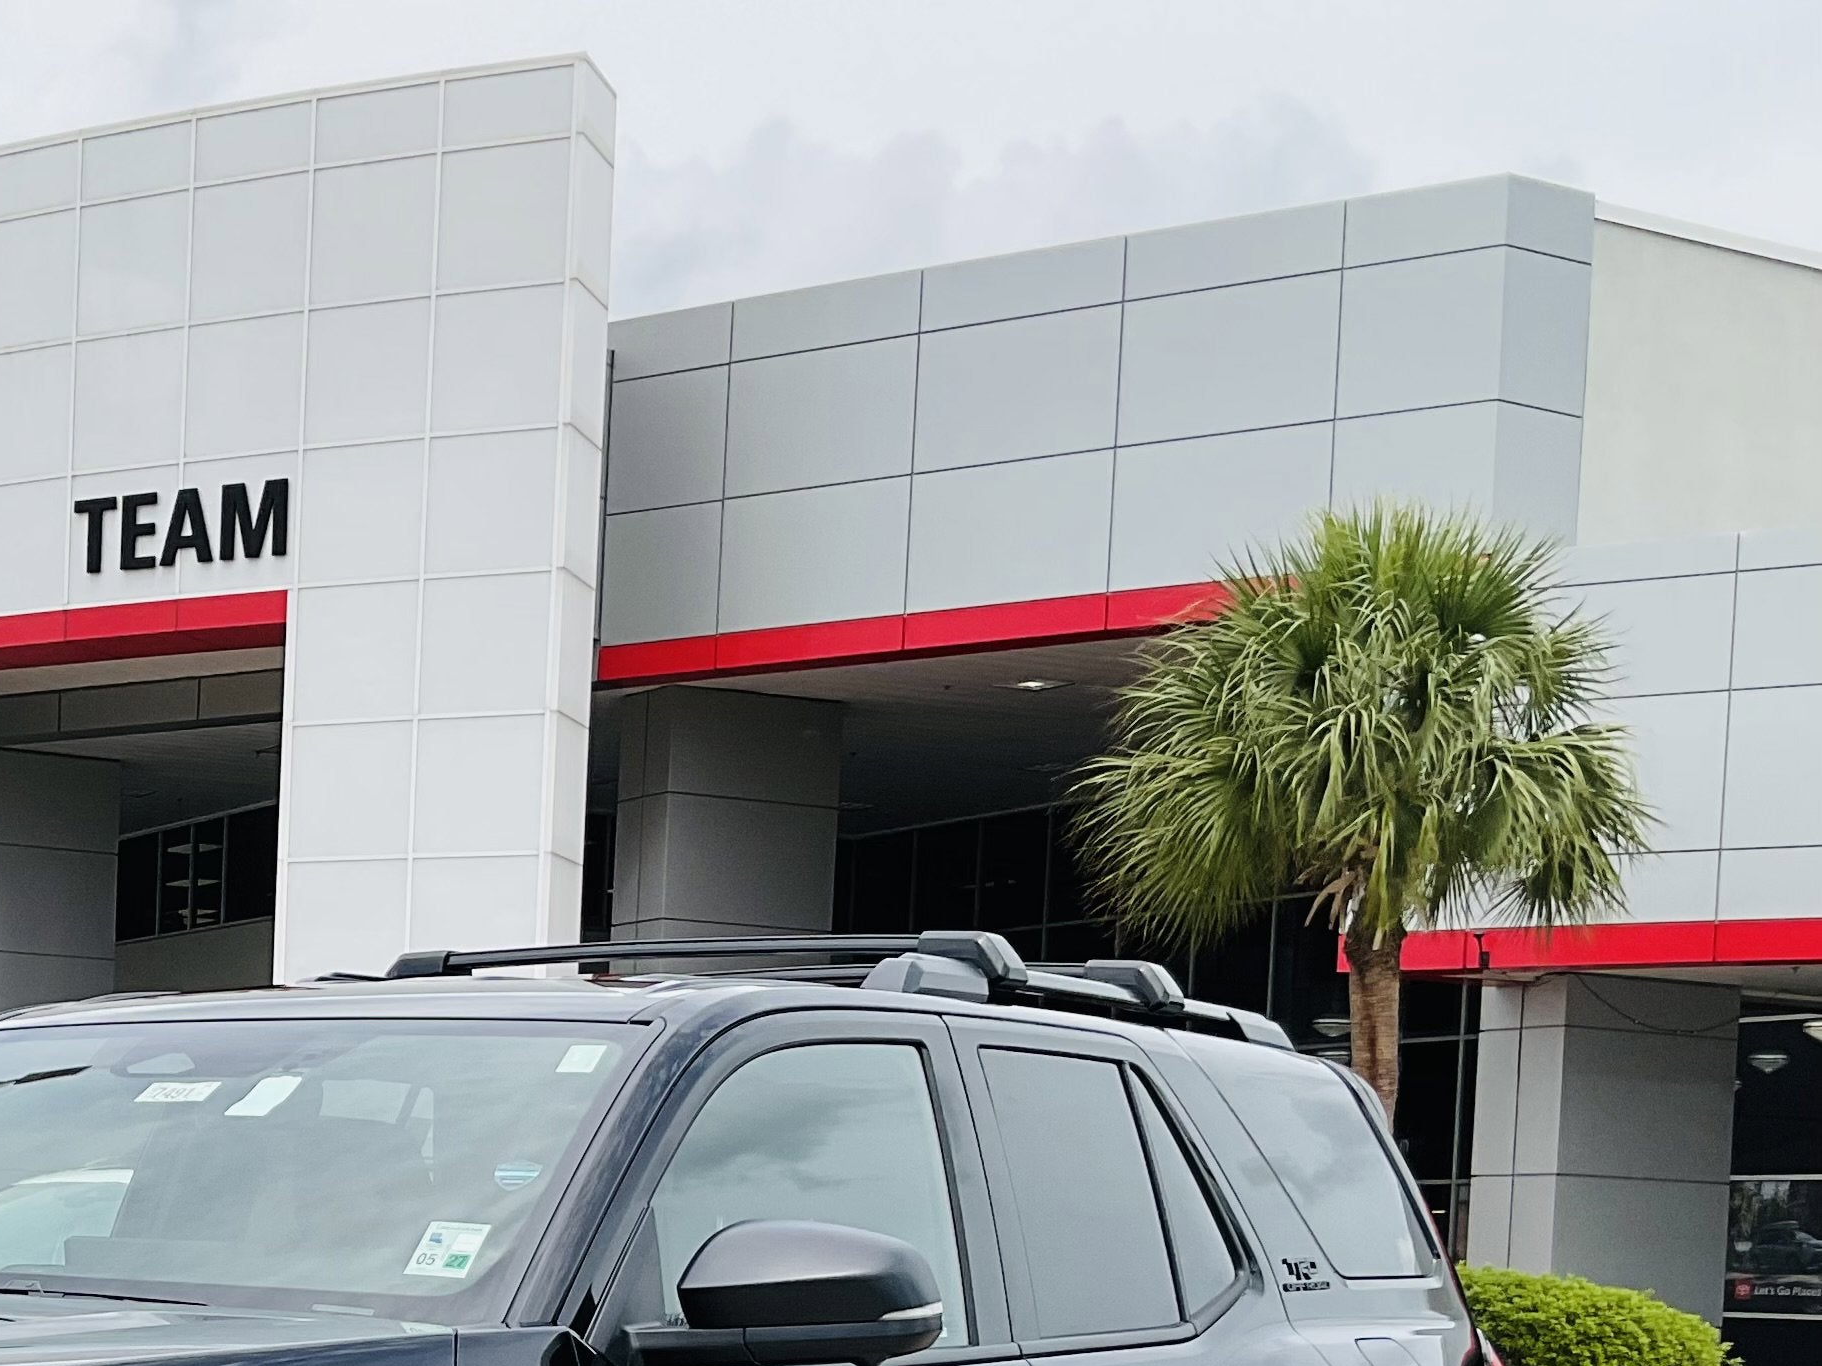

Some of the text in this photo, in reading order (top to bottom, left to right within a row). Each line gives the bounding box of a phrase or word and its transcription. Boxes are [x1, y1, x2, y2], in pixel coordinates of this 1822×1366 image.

[74, 478, 289, 574] TEAM
[415, 1252, 470, 1269] 05 27
[1753, 1286, 1775, 1296] Let's
[1777, 1285, 1791, 1296] Go
